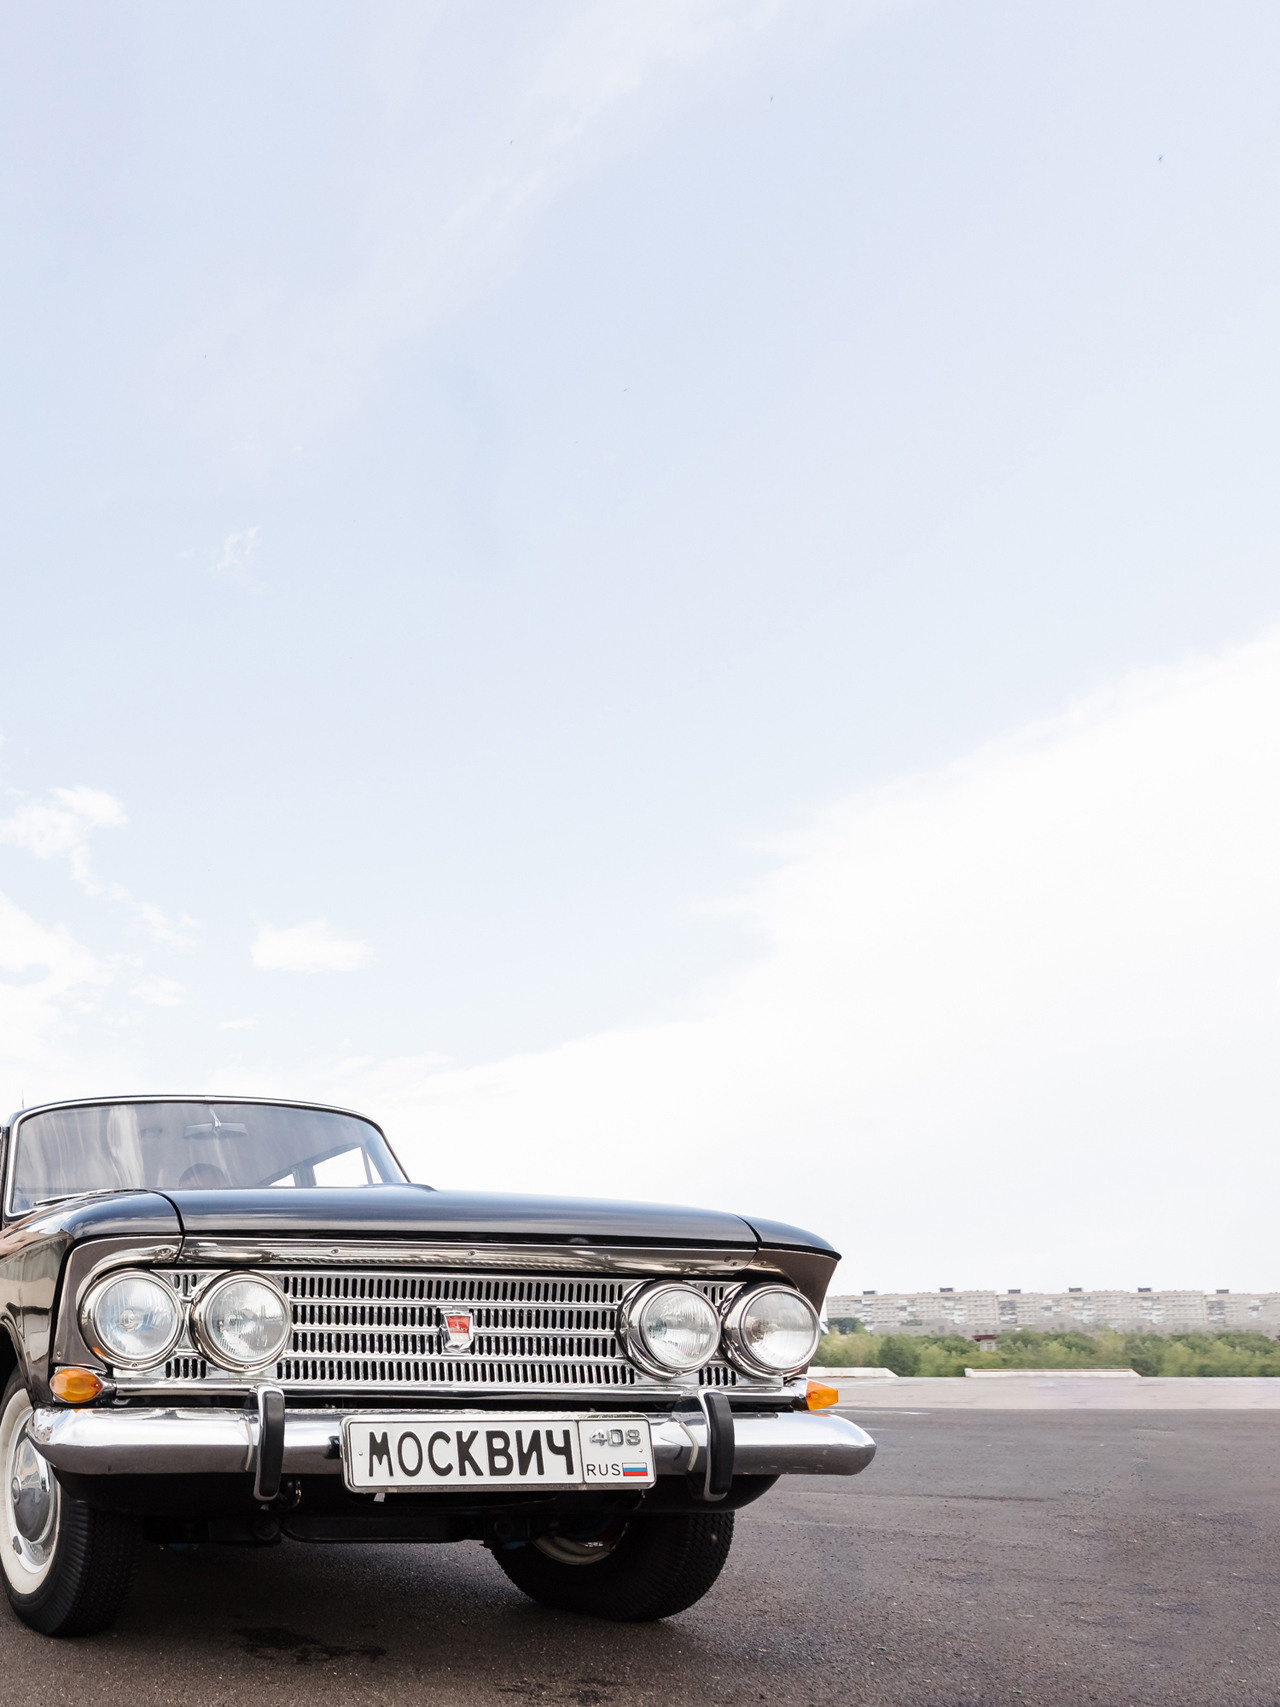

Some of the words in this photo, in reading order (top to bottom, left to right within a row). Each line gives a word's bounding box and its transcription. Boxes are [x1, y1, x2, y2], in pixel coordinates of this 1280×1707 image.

[589, 1429, 641, 1447] 408
[368, 1429, 574, 1477] МОСКВИЧ
[586, 1463, 621, 1476] RUS
